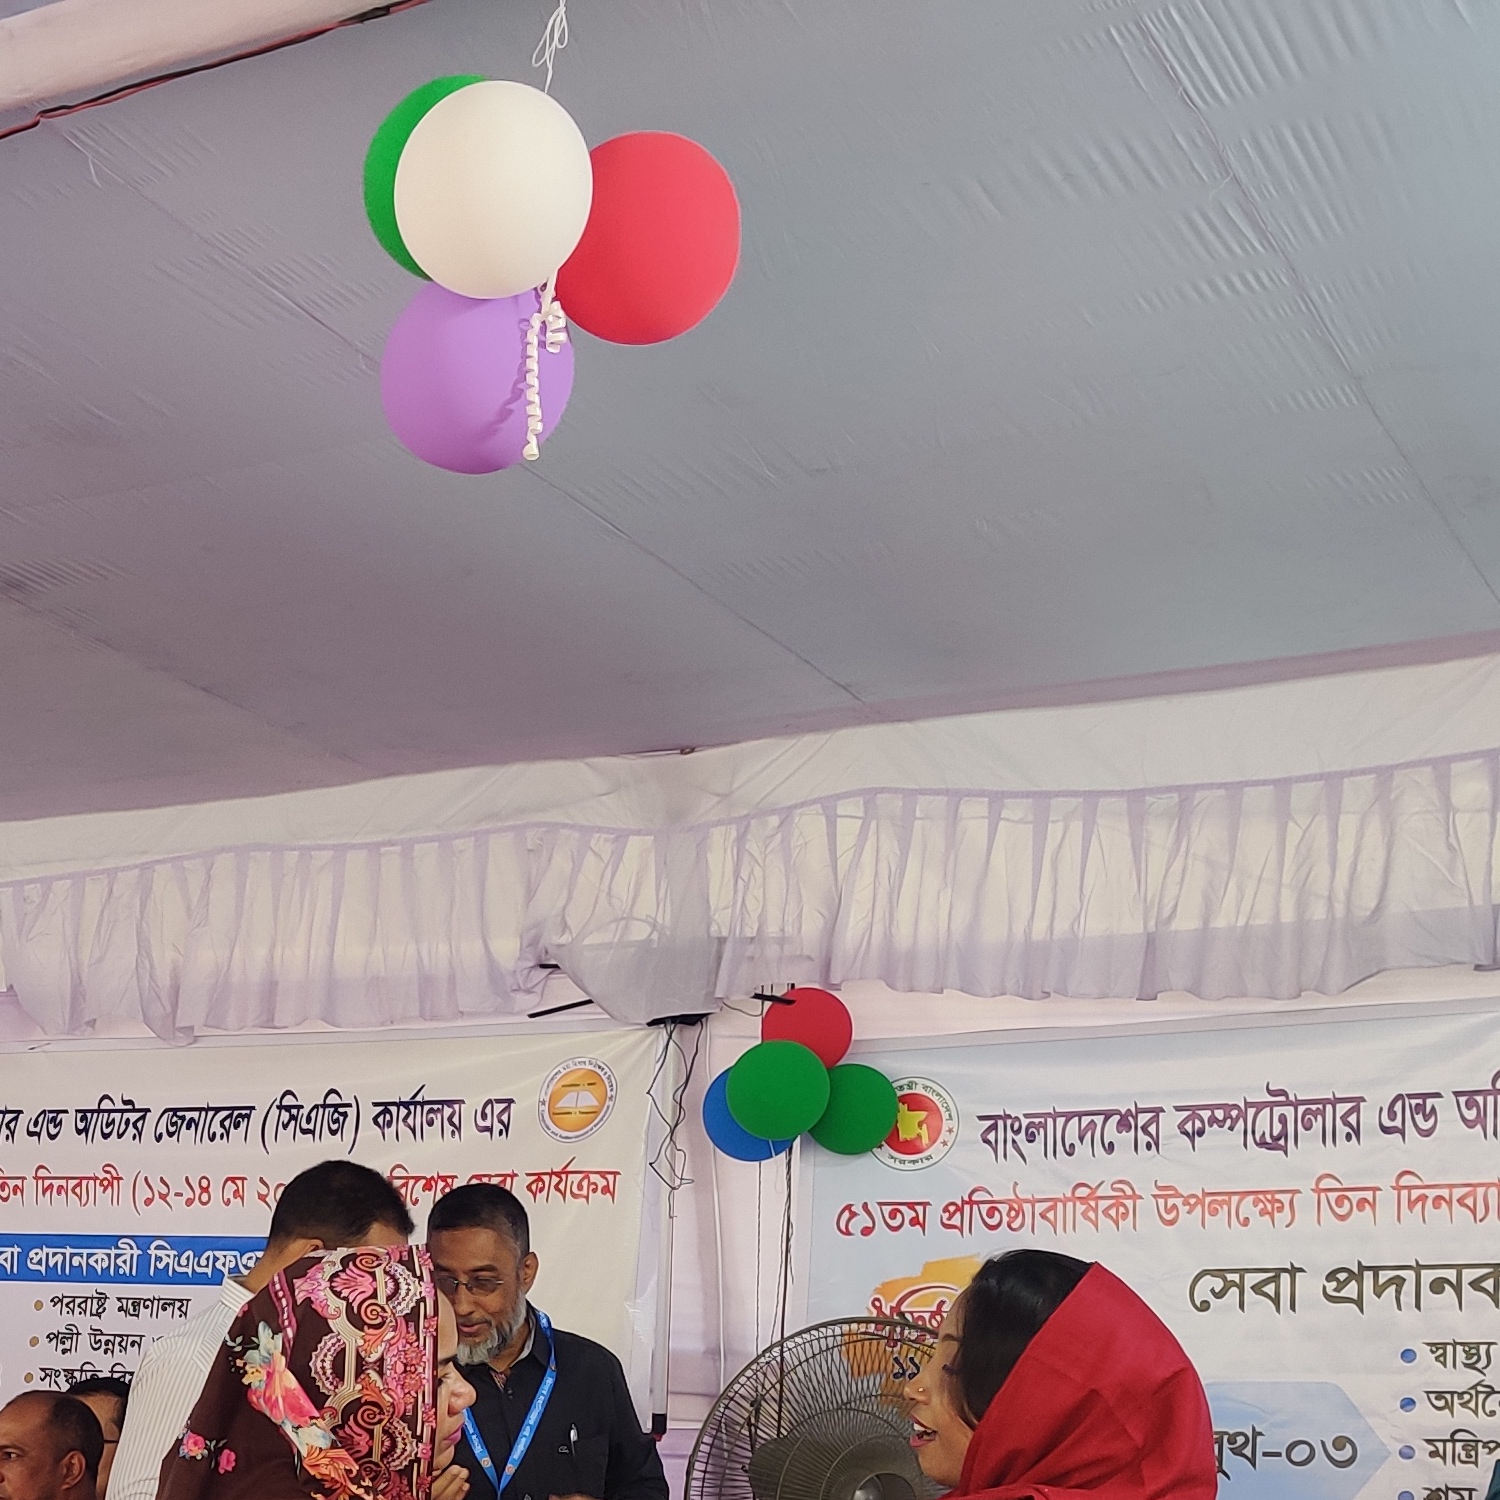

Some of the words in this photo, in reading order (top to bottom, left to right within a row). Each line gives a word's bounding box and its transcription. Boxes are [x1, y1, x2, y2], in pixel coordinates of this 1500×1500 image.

[26, 1108, 69, 1145] এন্ড
[74, 1092, 151, 1145] অডিটর
[154, 1102, 257, 1145] জেনারেল
[260, 1088, 360, 1155] (সিএজি)
[371, 1084, 466, 1143] কার্যালয়
[474, 1098, 516, 1142] এর
[975, 1100, 1166, 1166] বাংলাদেশের
[1172, 1081, 1366, 1158] কম্পট্রোলার
[1378, 1092, 1444, 1145] এন্ড
[32, 1163, 124, 1208] দিনব্যাপী
[221, 1176, 248, 1208] মে
[525, 1156, 622, 1205] কার্যক্রম
[836, 1200, 932, 1237] ৫১তম
[940, 1179, 1143, 1239] প্রতিষ্ঠাবার্ষিকী
[1150, 1180, 1302, 1230] উপলক্ষ্যে
[1310, 1173, 1383, 1226] তিন
[26, 1239, 142, 1277] প্রদানকারী
[115, 1295, 192, 1320] মন্ত্রণালয়
[1189, 1261, 1307, 1315] সেবা
[46, 1324, 81, 1355] পল্লী
[88, 1325, 146, 1358] উন্নয়ন
